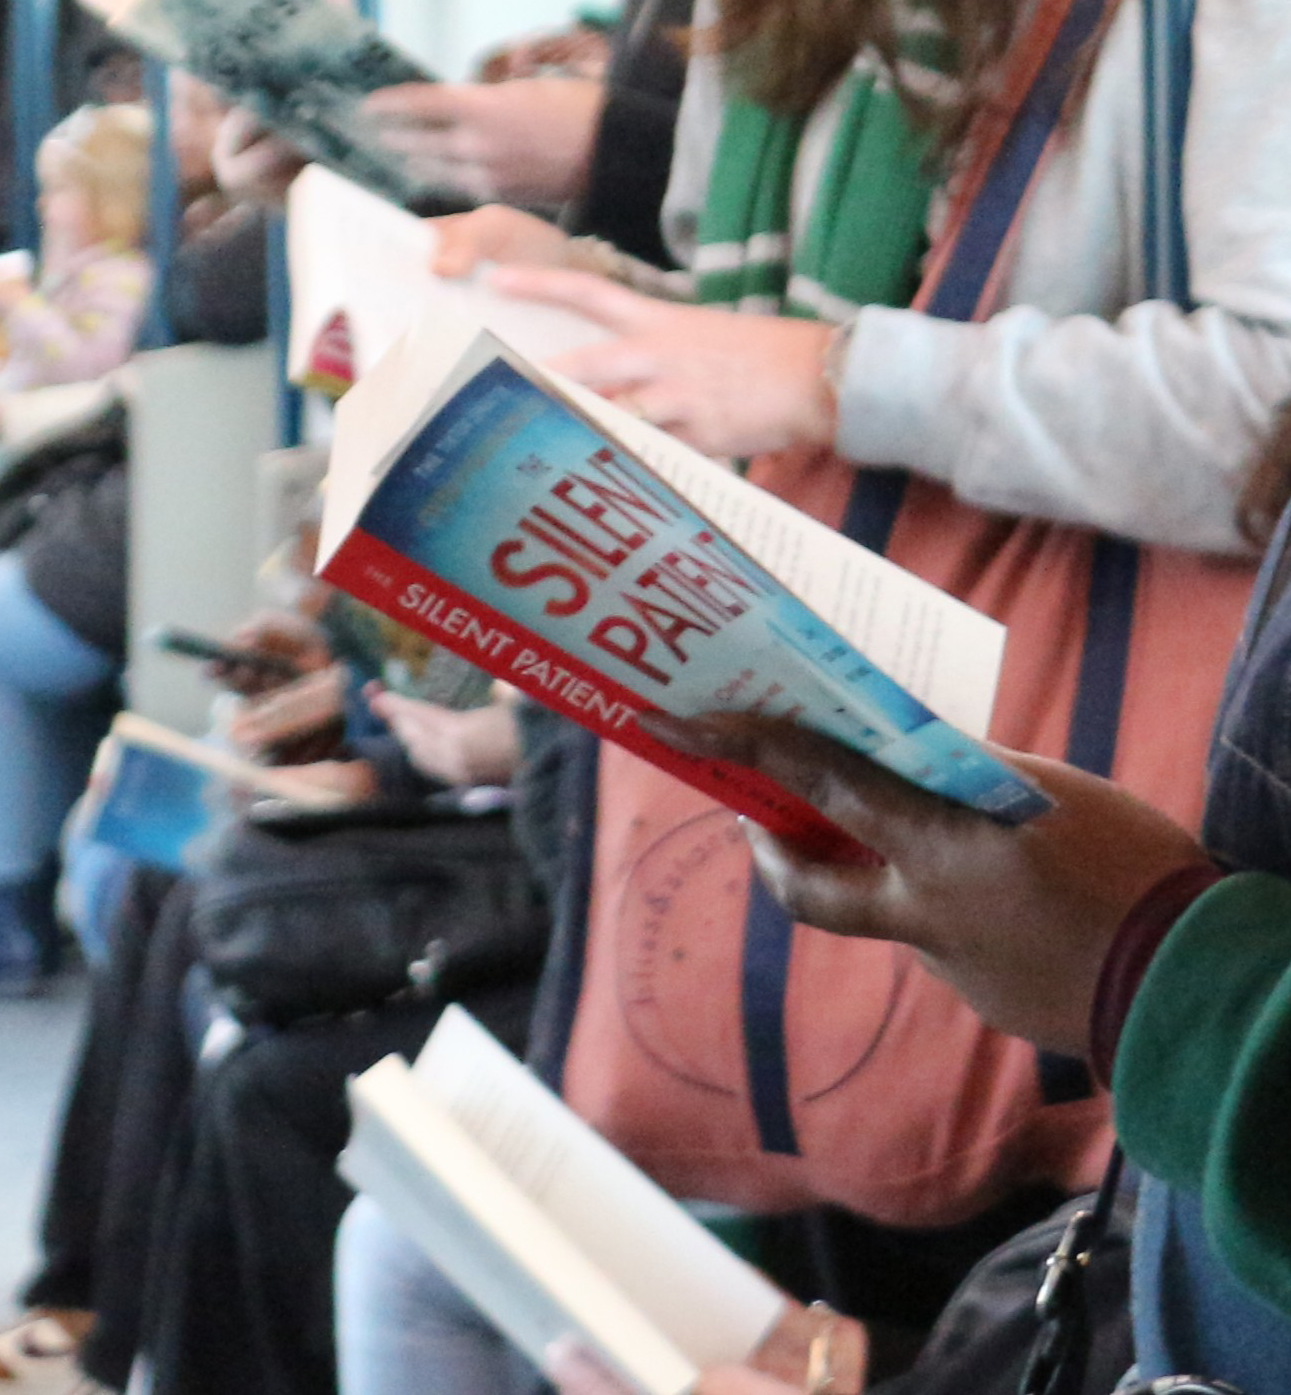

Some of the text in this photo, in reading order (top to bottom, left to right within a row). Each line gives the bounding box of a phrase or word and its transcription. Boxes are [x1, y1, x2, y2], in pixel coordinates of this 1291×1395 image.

[490, 447, 683, 617] SILENT
[397, 583, 514, 656] SILENT
[510, 648, 638, 729] PATIENT
